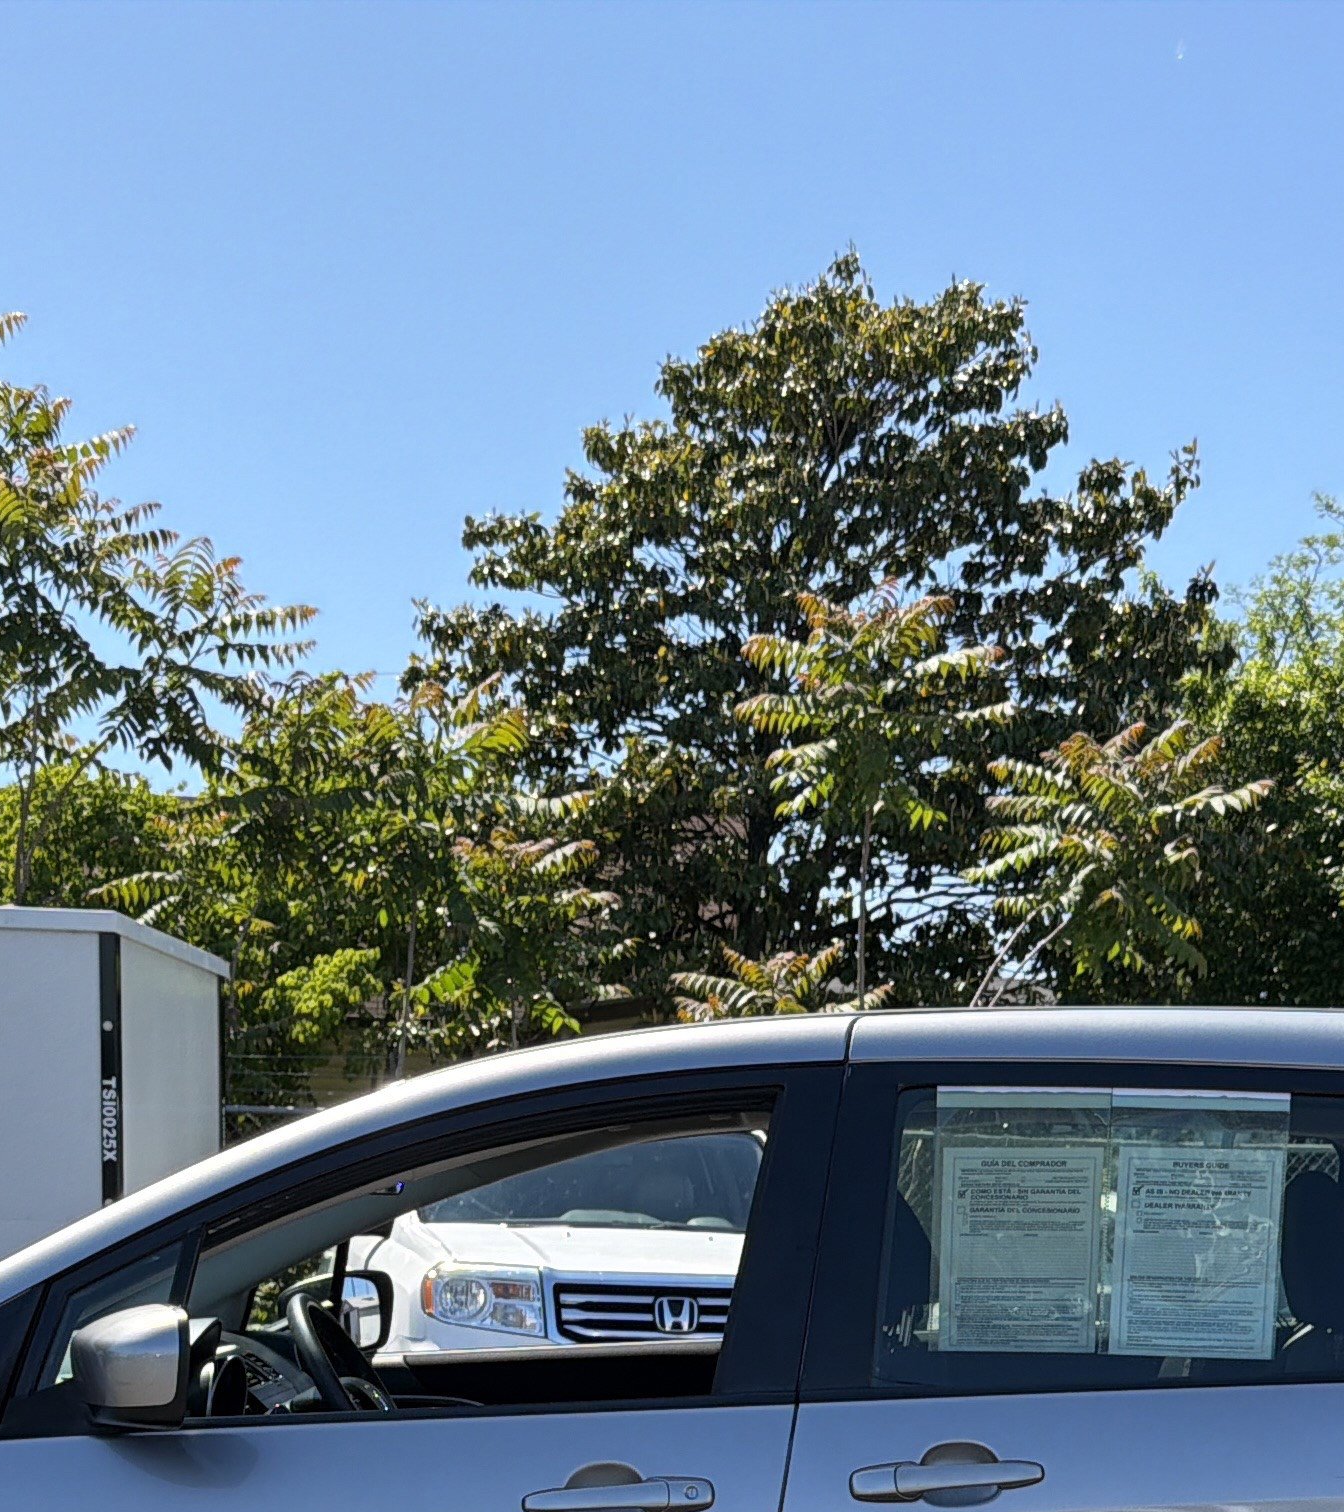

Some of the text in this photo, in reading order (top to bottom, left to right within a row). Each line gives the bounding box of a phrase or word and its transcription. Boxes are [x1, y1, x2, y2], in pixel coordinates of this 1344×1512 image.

[980, 1159, 999, 1167] GUÍA
[1172, 1161, 1204, 1169] BUYERS
[1144, 1202, 1173, 1210] DEALER
